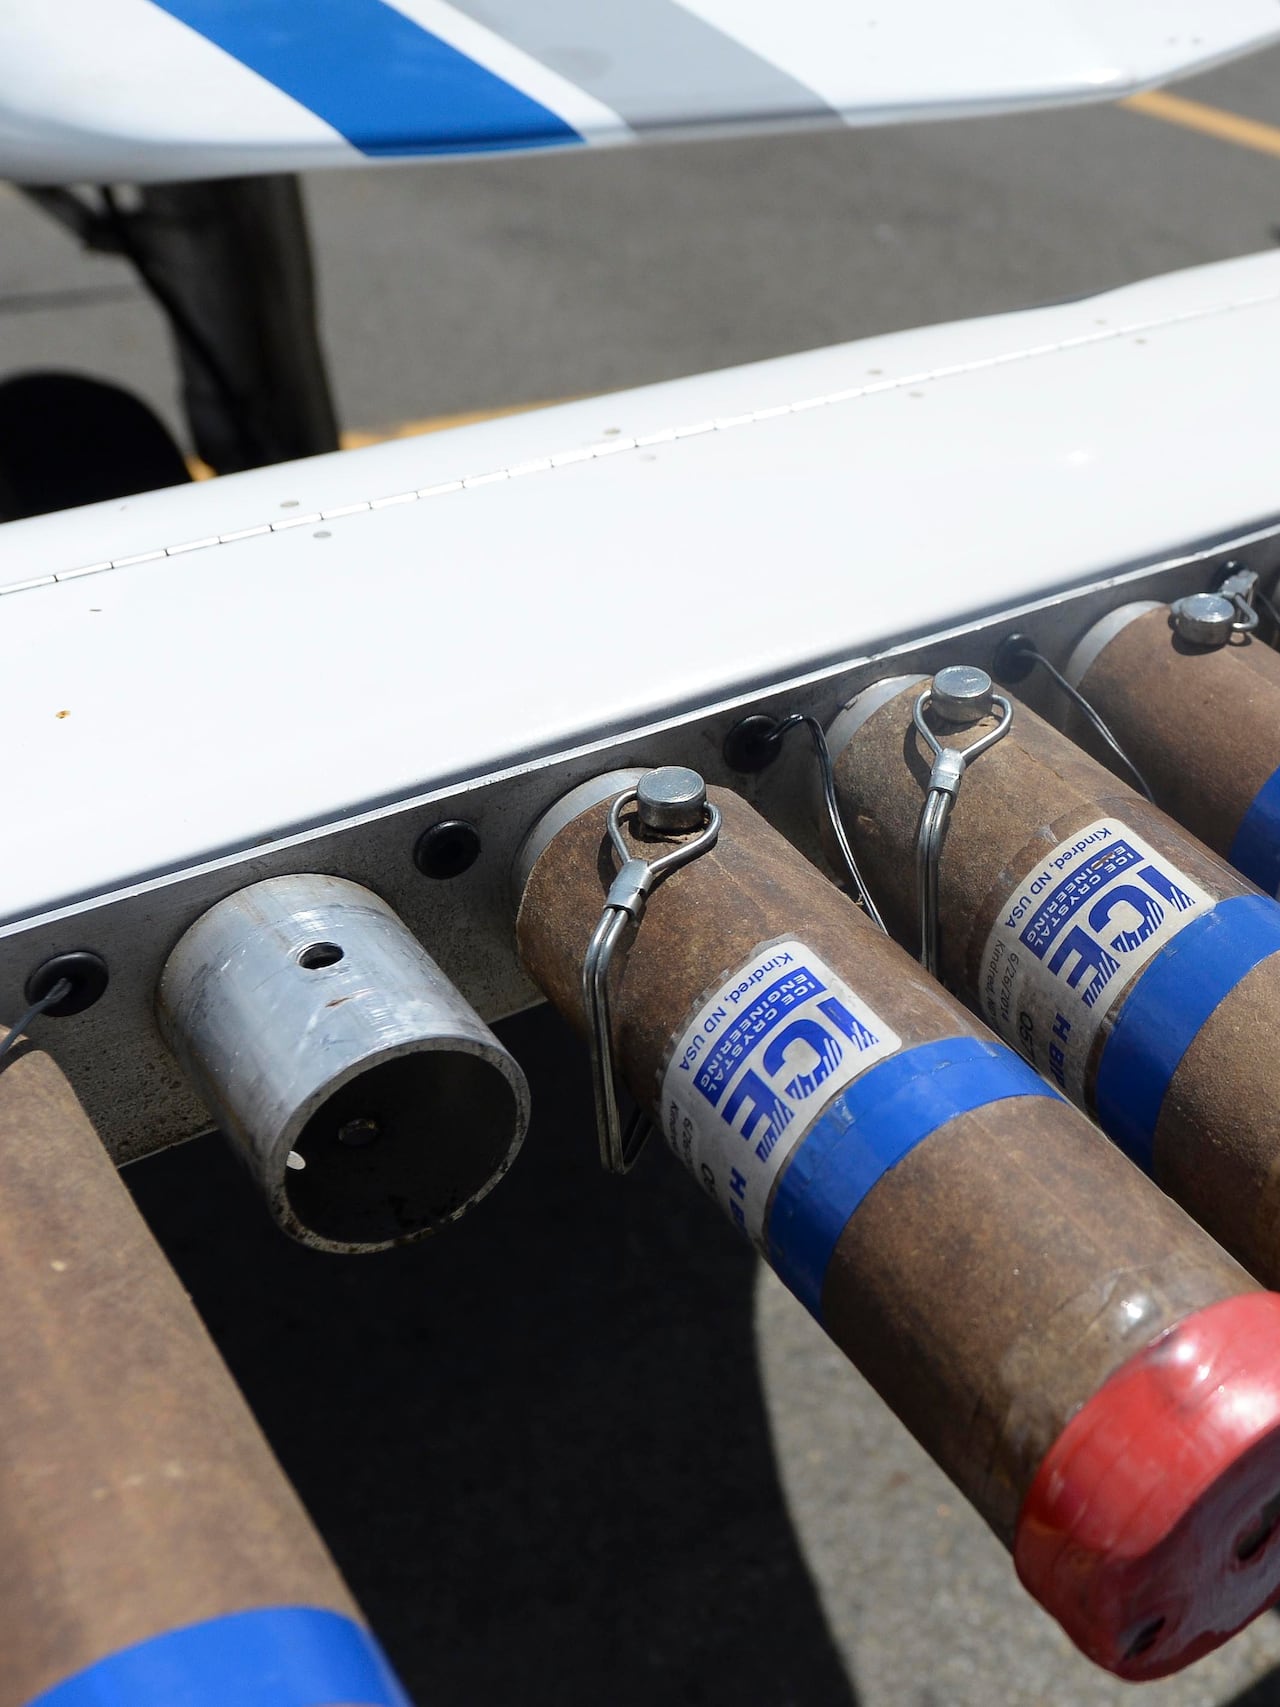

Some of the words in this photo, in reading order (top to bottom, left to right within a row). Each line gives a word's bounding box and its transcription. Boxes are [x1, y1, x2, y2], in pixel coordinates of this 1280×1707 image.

[1049, 827, 1112, 870] Kindred,
[1104, 852, 1134, 873] ICE
[1030, 871, 1053, 893] ND
[1005, 896, 1032, 928] USA
[1034, 874, 1100, 947] CRYSTAL
[1047, 865, 1196, 1008] ICE
[724, 952, 794, 1005] Kindred,
[782, 981, 815, 1005] ICE
[700, 974, 807, 1088] ENGINEERING
[703, 1008, 727, 1033] ND
[1052, 1012, 1072, 1043] H
[679, 1036, 706, 1071] USA
[708, 1007, 778, 1092] CRYSTAL
[720, 996, 880, 1163] ICE
